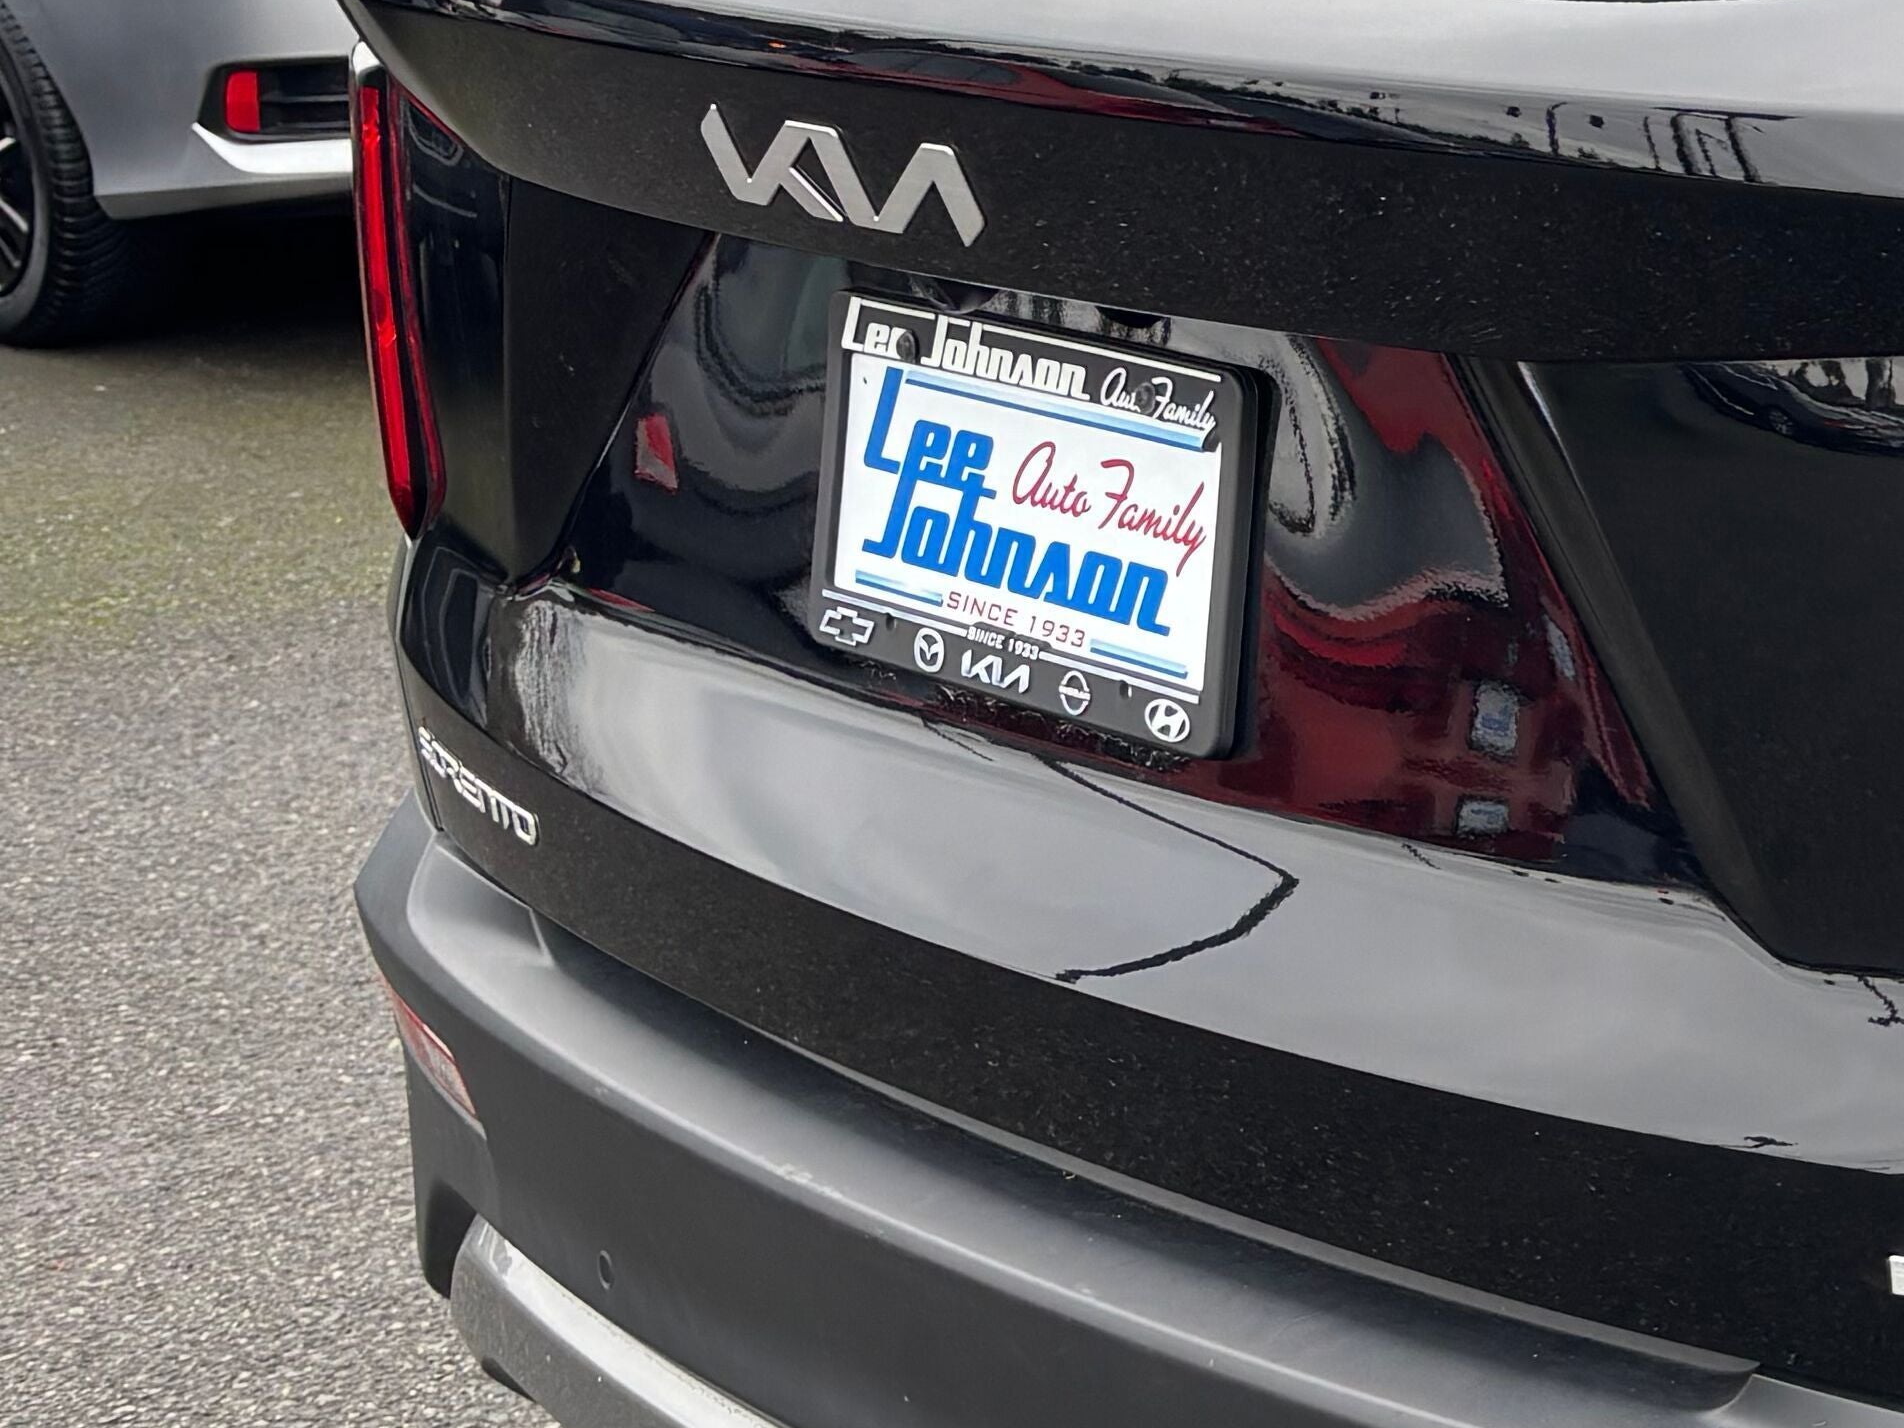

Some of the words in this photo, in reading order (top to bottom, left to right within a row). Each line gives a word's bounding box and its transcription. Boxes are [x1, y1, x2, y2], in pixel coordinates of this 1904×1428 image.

[700, 103, 986, 248] KIA
[863, 366, 995, 494] Lee
[920, 314, 1090, 401] Johnson
[1151, 376, 1217, 449] Family
[861, 471, 1171, 637] Johnson
[1012, 440, 1092, 518] Auto
[1098, 458, 1207, 578] Family
[946, 590, 1019, 627] SINCE
[1030, 614, 1086, 649] 1933
[961, 648, 1031, 694] KIA
[966, 625, 1005, 650] SINCE
[1007, 636, 1041, 662] 1933
